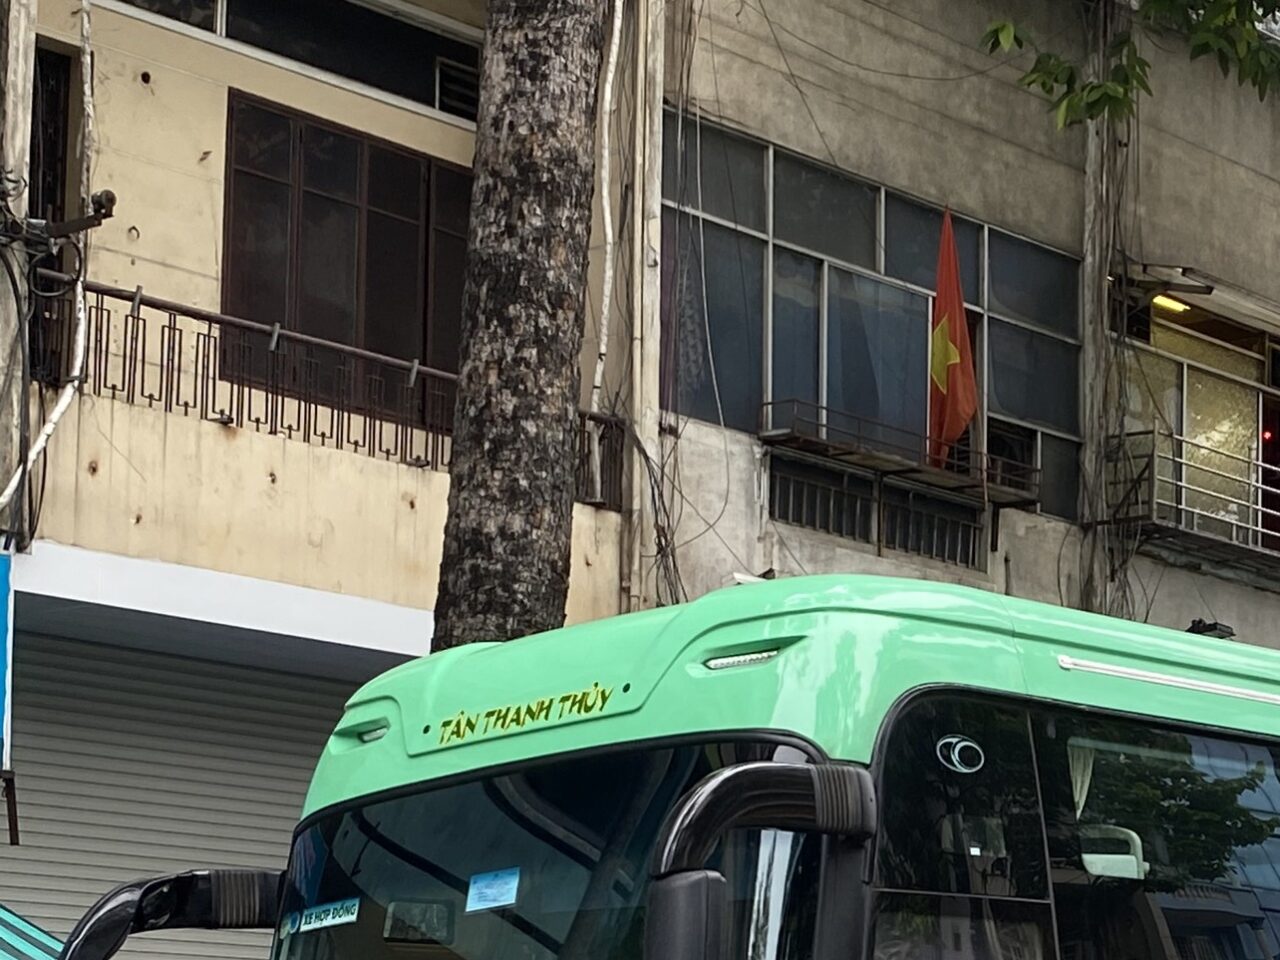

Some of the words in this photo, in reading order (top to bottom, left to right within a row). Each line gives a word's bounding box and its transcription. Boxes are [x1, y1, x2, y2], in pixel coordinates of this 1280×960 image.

[439, 710, 480, 745] TÂN
[483, 698, 555, 735] THANH
[558, 681, 614, 720] THỦY
